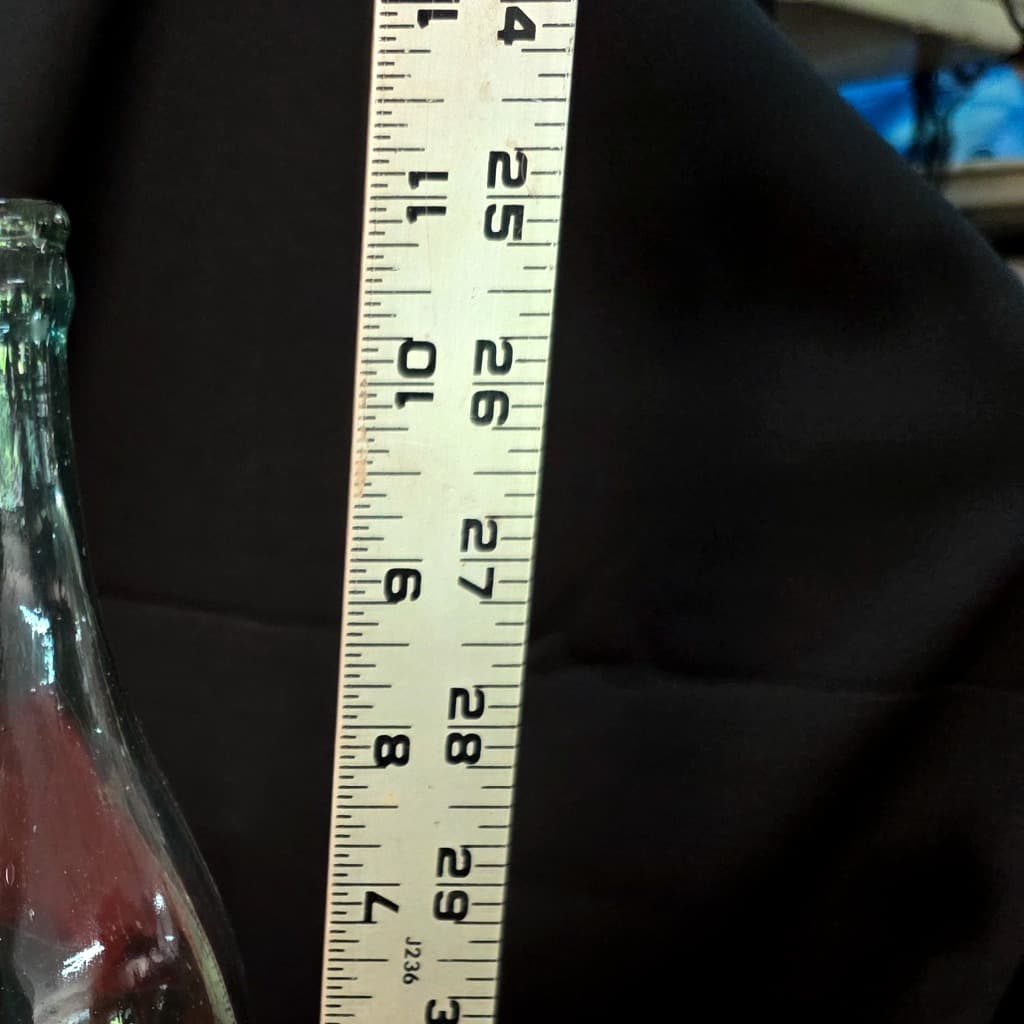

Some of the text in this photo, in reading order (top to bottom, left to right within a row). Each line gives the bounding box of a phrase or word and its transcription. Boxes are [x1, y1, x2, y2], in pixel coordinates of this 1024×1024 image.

[406, 171, 449, 224] 11
[483, 150, 528, 241] 25
[394, 339, 437, 410] 10
[470, 339, 514, 427] 26
[383, 567, 422, 603] 9
[458, 518, 498, 600] 27
[374, 733, 411, 767] 8
[444, 687, 486, 765] 28
[363, 891, 400, 924] 7
[433, 847, 472, 922] 29
[402, 936, 422, 985] J236
